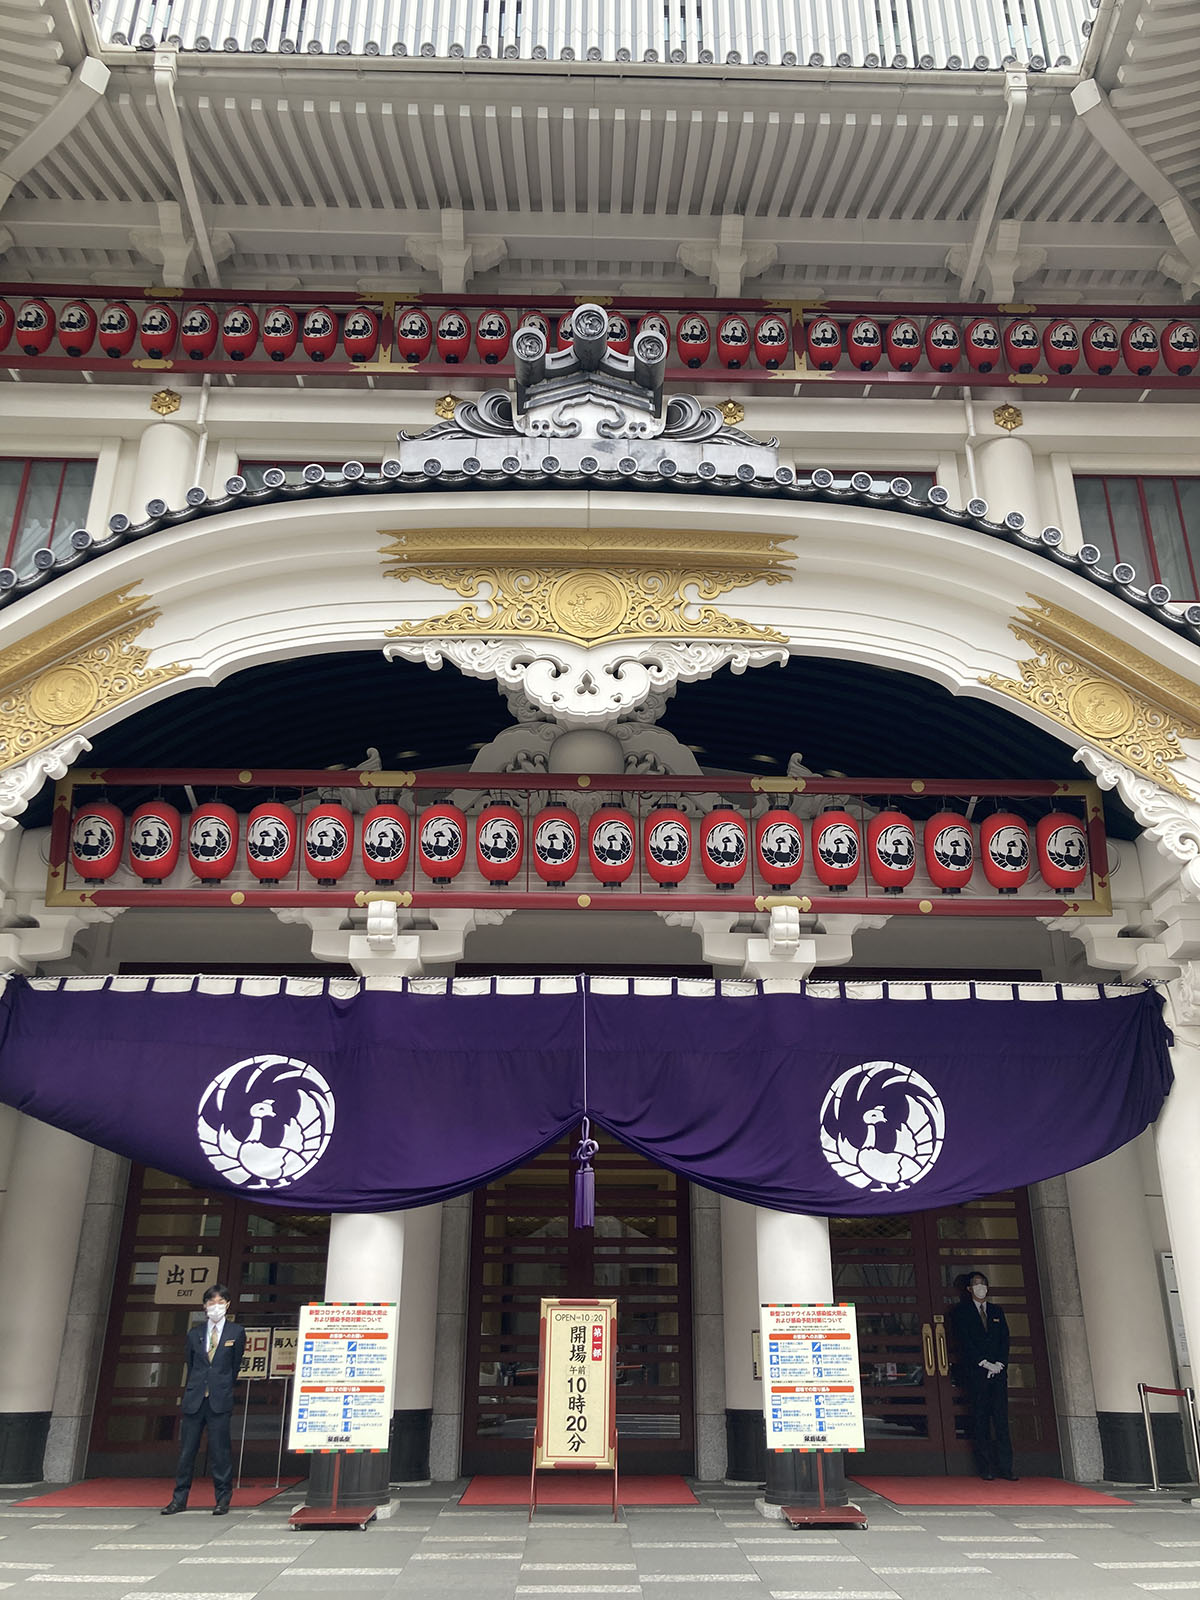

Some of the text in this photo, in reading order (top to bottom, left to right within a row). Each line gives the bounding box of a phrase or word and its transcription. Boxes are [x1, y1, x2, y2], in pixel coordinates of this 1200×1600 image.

[166, 1264, 209, 1285] 出口
[177, 1289, 194, 1297] EXIT
[555, 1313, 576, 1322] OPEN
[274, 1337, 298, 1348] 再入
